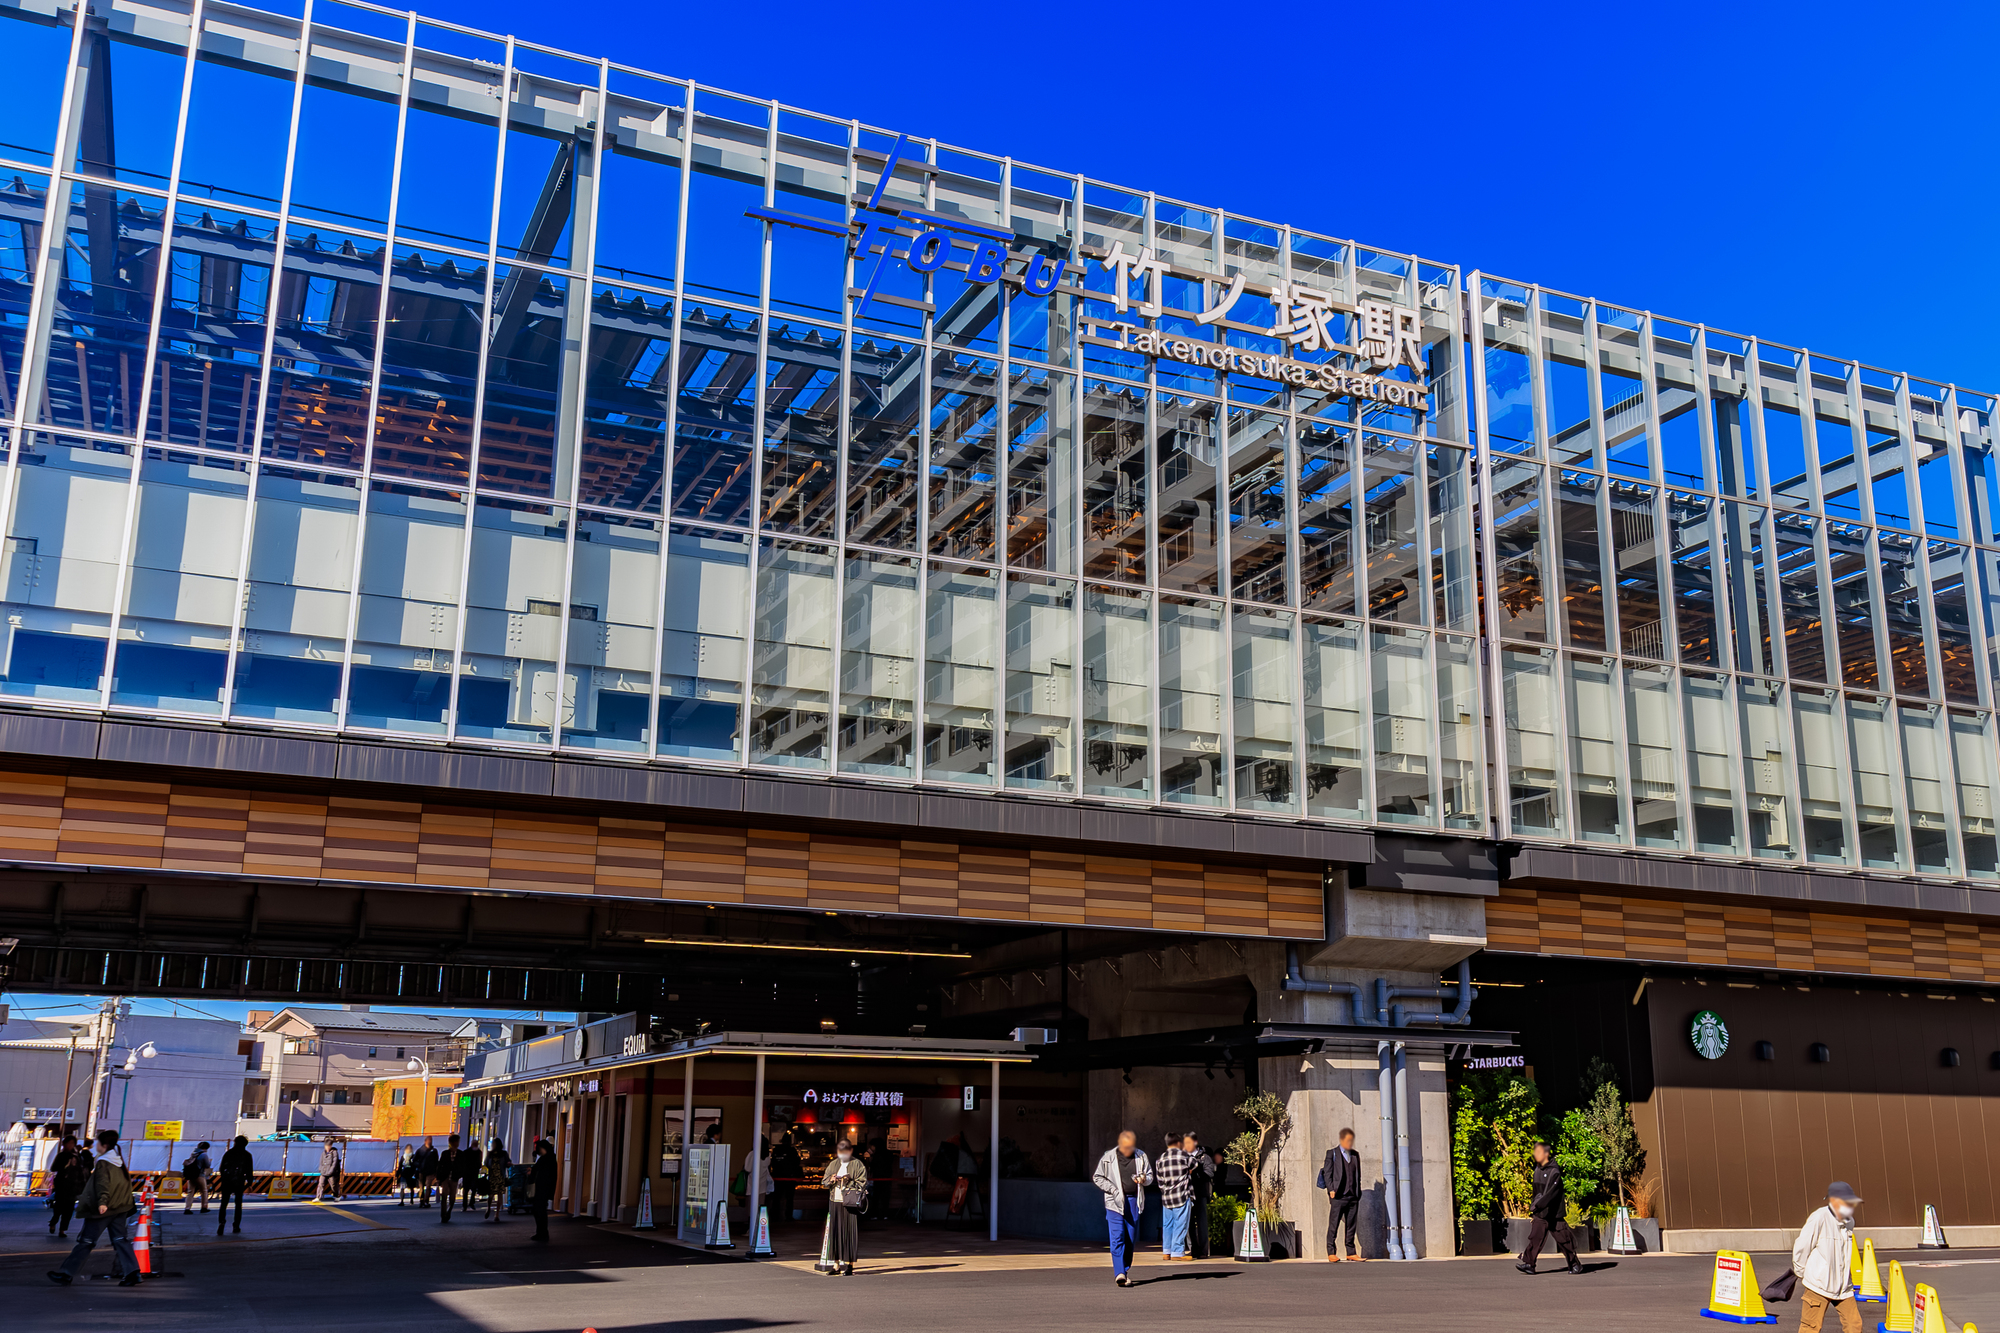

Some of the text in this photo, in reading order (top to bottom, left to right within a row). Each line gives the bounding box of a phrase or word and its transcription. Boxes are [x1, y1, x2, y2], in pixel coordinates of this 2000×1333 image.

[852, 210, 1067, 298] TOBU
[1100, 240, 1425, 377] 竹ノ塚駅
[1109, 320, 1420, 409] Takenotsuka Station
[821, 1090, 904, 1107] おむすび権米衛
[1468, 1055, 1525, 1070] STARBUCKS
